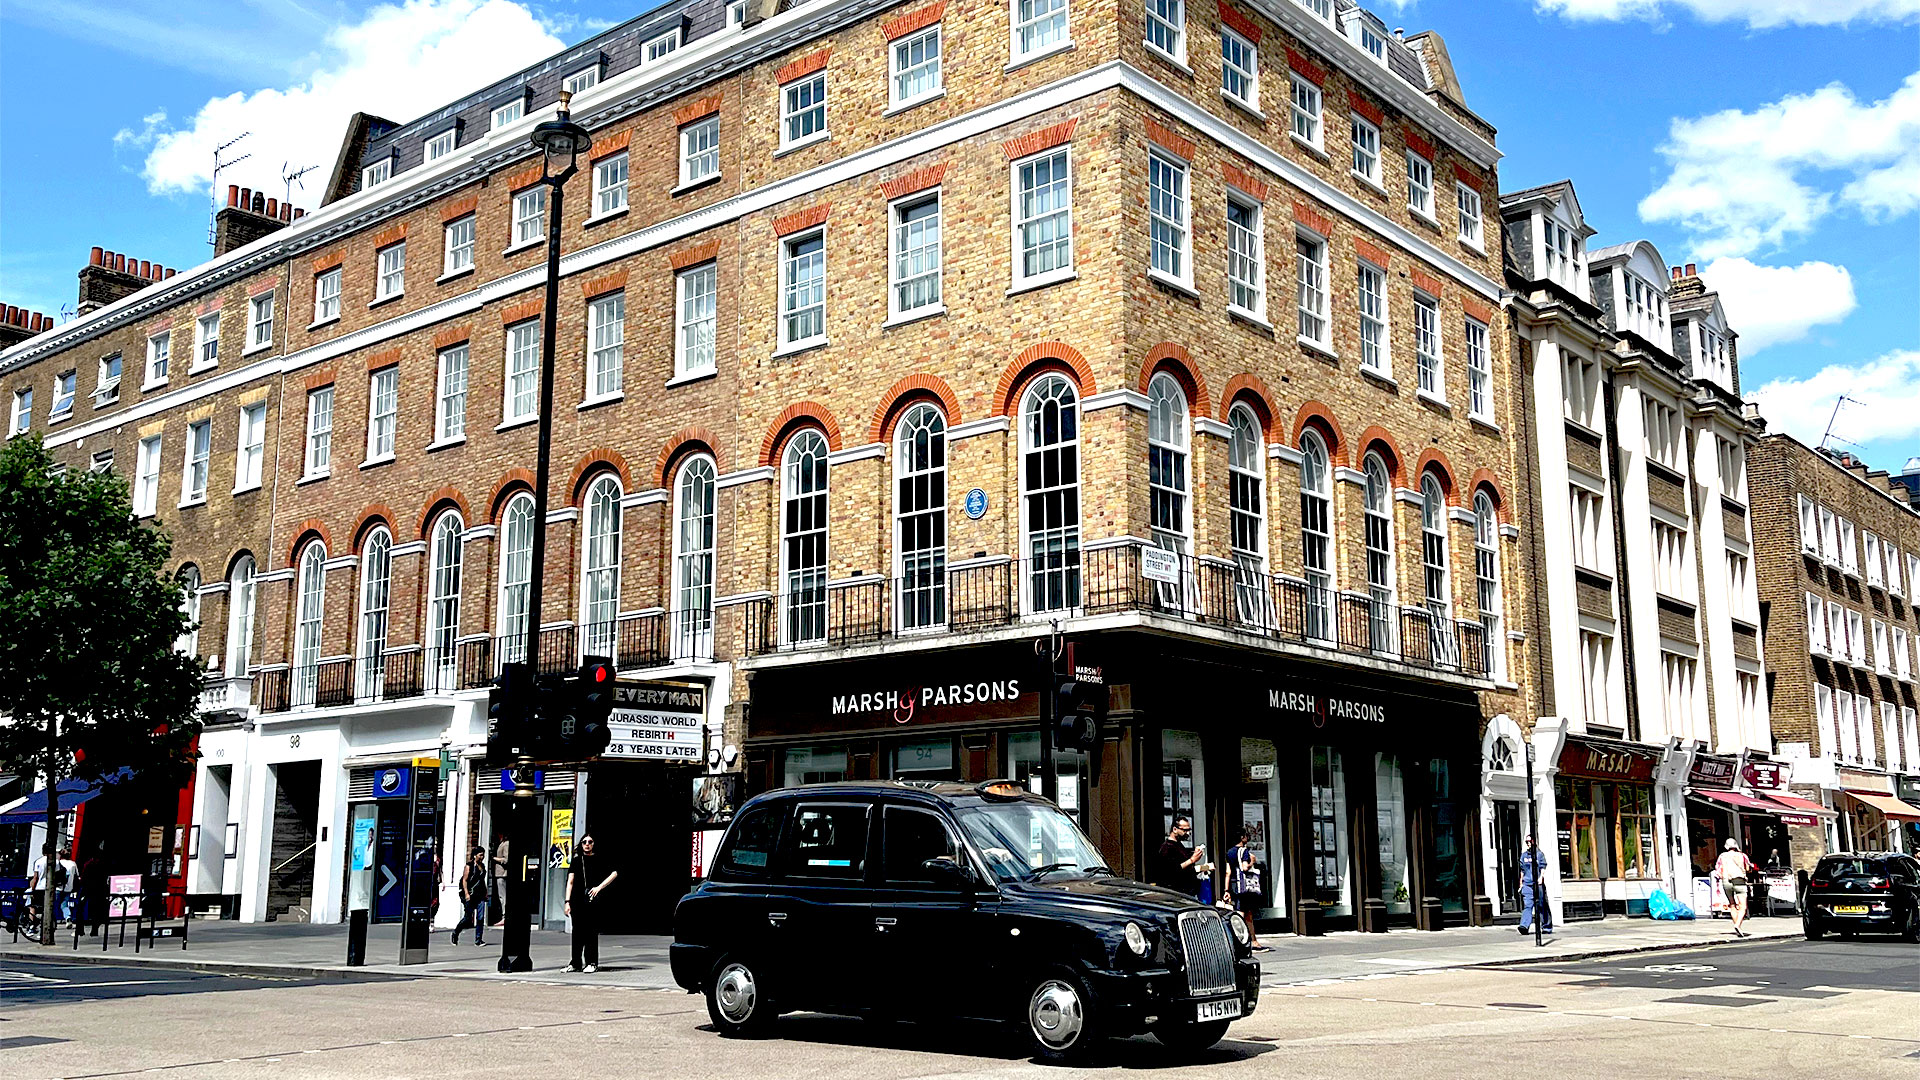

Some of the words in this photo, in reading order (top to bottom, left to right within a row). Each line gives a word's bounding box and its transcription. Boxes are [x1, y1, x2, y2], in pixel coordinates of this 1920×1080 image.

[1146, 550, 1176, 563] PADDINGTON
[1146, 559, 1163, 570] STREET
[1075, 665, 1097, 676] MARSH
[1075, 674, 1103, 685] PARSONS
[616, 687, 701, 707] EVERYMAN
[832, 690, 898, 715] MARSH
[922, 680, 1020, 707] PARSONS
[1269, 689, 1315, 713] MARSH
[1329, 698, 1385, 723] PARSONS
[610, 713, 659, 725] JURASSIC
[662, 716, 697, 727] WORLD
[290, 734, 301, 749] 98
[631, 729, 675, 741] REBIRTH
[610, 743, 624, 754] 28
[630, 744, 663, 756] YEARS
[666, 746, 697, 757] LATER
[916, 747, 933, 761] 94
[1586, 751, 1633, 774] MASAJ
